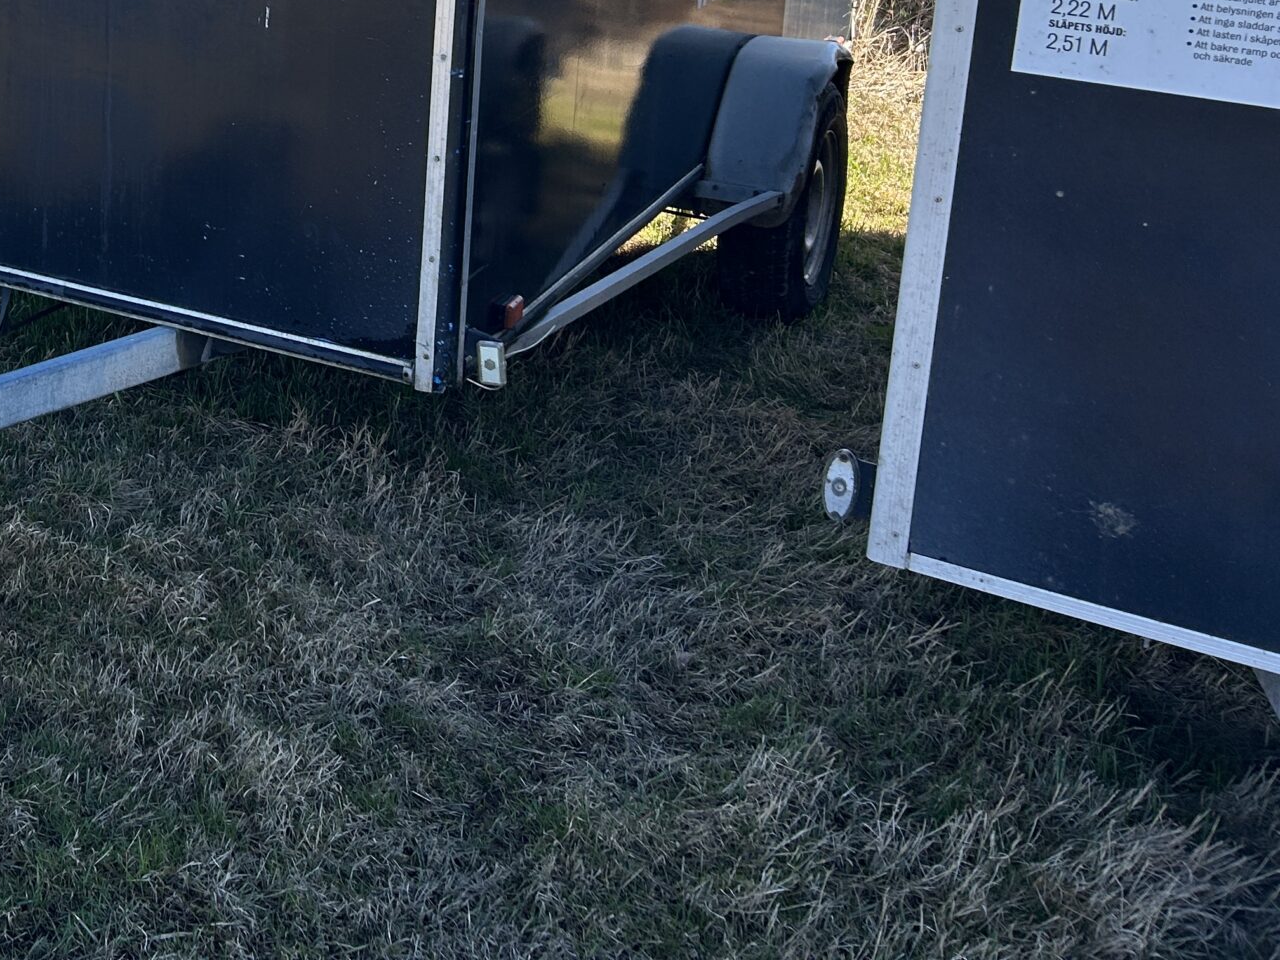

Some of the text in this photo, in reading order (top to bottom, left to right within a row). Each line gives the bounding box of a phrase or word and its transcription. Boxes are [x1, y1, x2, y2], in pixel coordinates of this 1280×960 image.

[1097, 2, 1116, 21] M
[1200, 2, 1214, 12] Att
[1216, 4, 1274, 19] belysningen
[1048, 18, 1127, 37] SLÄPETS HÖJD:
[1198, 15, 1212, 25] Att
[1214, 16, 1235, 28] inga
[1237, 20, 1275, 32] sladdar
[1046, 32, 1108, 57] 2,51 M
[1196, 27, 1210, 37] Att
[1213, 29, 1242, 41] lasten
[1249, 34, 1280, 46] skåpe
[1194, 40, 1208, 50] Att
[1210, 42, 1239, 54] bakre
[1241, 47, 1268, 58] ramp
[1193, 52, 1253, 67] och säkrade
